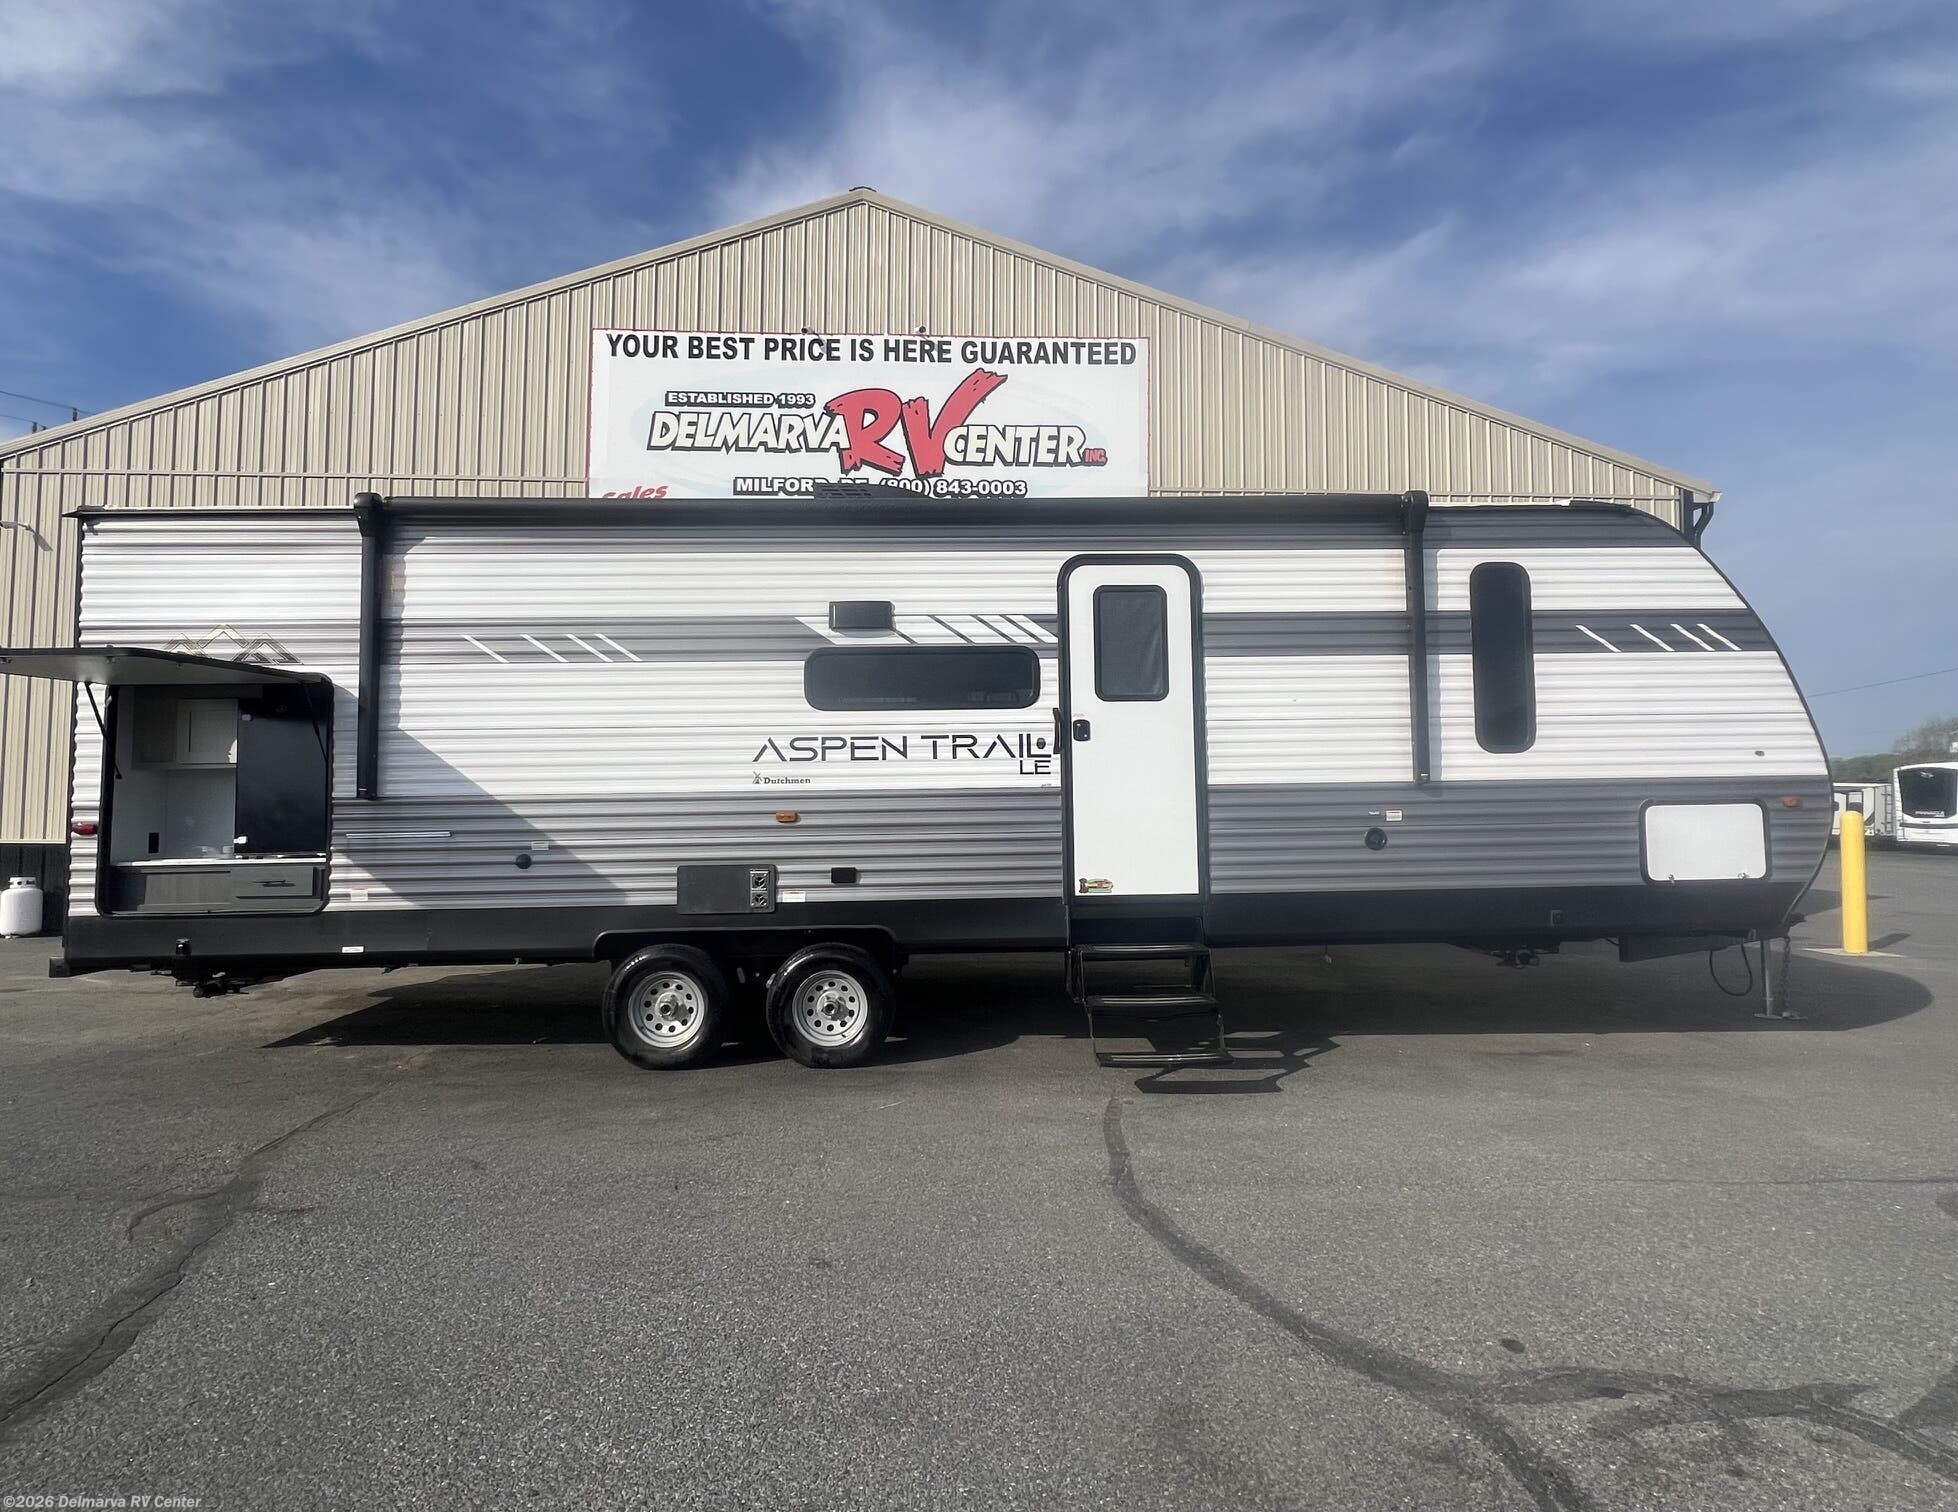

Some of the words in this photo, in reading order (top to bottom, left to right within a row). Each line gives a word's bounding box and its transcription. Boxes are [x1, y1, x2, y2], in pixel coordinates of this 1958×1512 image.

[606, 334, 679, 359] YOUR
[687, 336, 755, 360] BEST
[764, 338, 841, 362] PRICE
[850, 339, 874, 362] IS
[883, 339, 952, 363] HERE
[961, 341, 1137, 365] GUARANTEED
[666, 392, 775, 406] ESTABLISHED
[777, 392, 816, 407] 1993
[648, 411, 851, 453] DELMARVA
[824, 368, 1008, 477] RV
[943, 424, 1086, 466] CENTER
[734, 477, 829, 494] MILFOR
[934, 479, 1027, 495] 843-0003
[752, 735, 908, 762] ASPEN
[921, 733, 1052, 759] TRAIL
[1020, 759, 1052, 775] LE
[763, 776, 811, 784] Dutchmen
